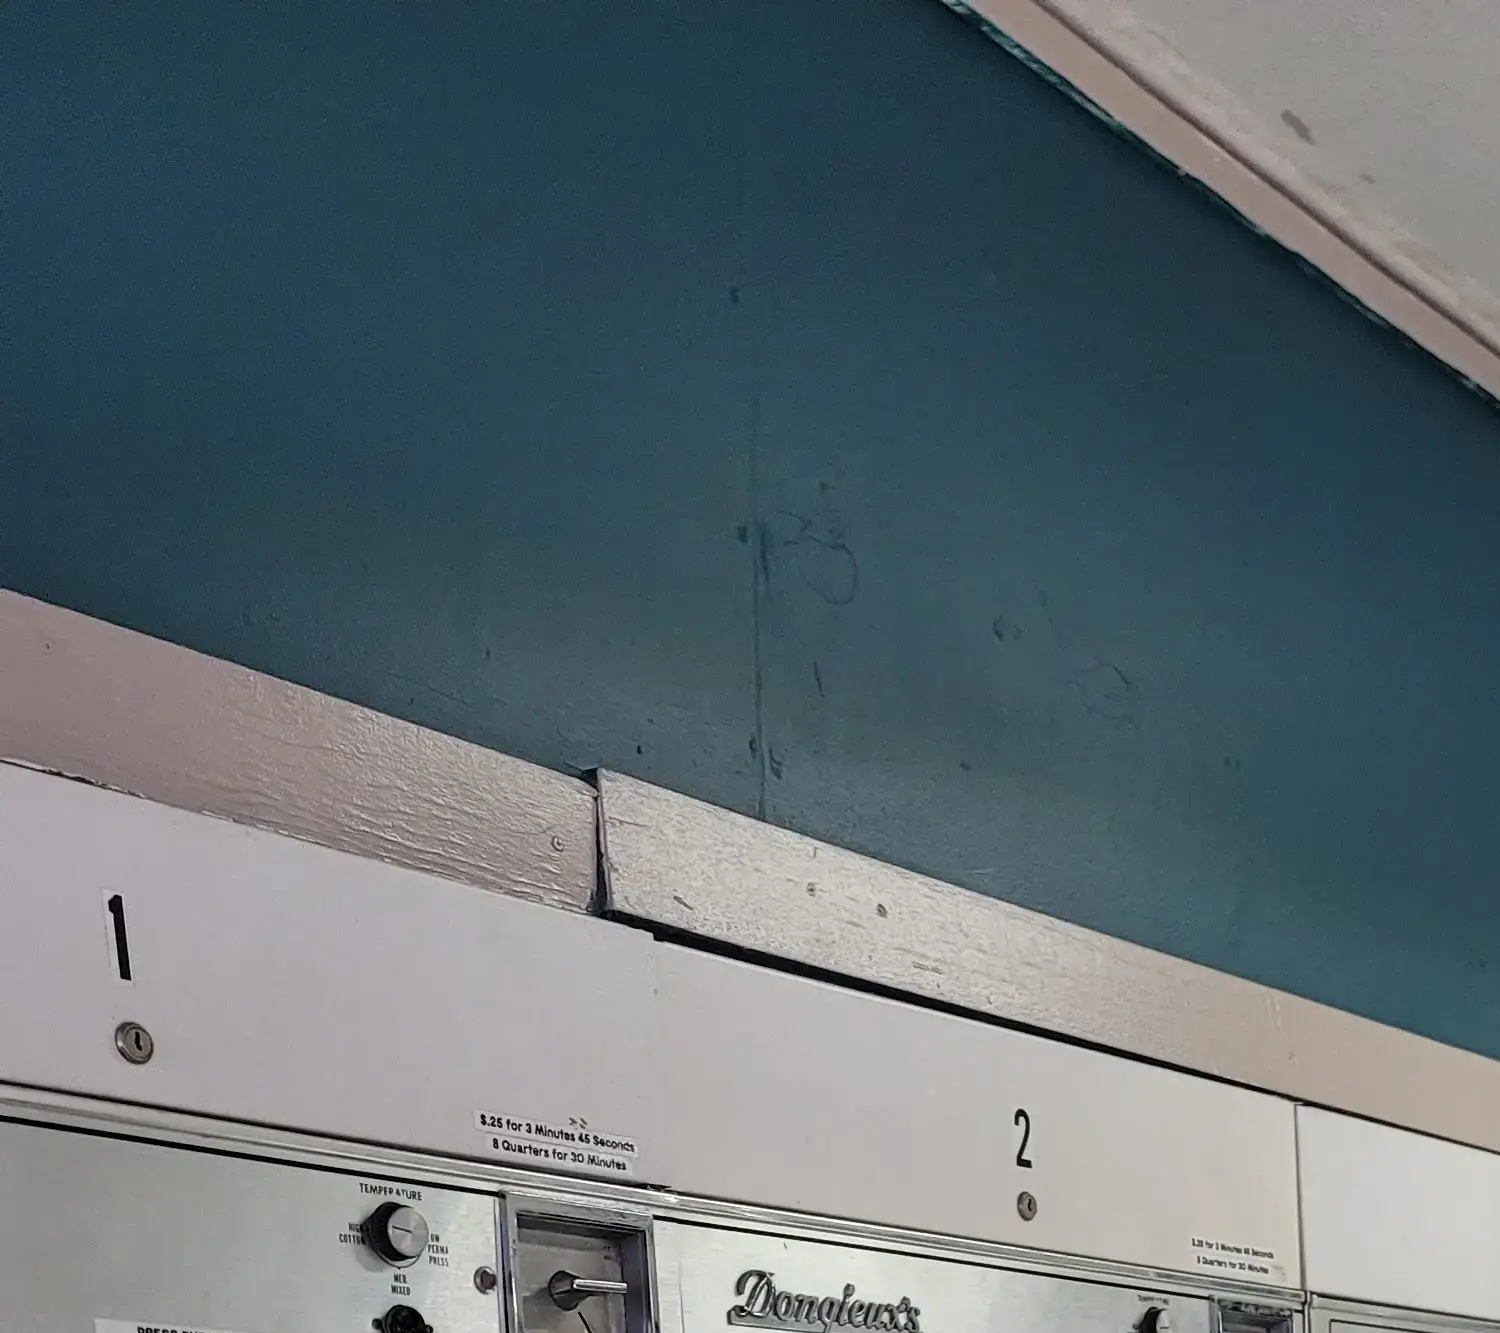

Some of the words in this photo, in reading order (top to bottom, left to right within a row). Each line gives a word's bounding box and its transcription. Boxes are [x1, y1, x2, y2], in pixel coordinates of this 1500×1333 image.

[108, 894, 132, 981] 1
[480, 1113, 503, 1129] $.25
[506, 1119, 523, 1132] for
[526, 1122, 532, 1134] 3
[535, 1124, 575, 1142] Minutes
[578, 1132, 590, 1144] 45
[593, 1134, 635, 1152] Seconds
[492, 1138, 499, 1149] 8
[502, 1139, 550, 1158] Quarters
[552, 1149, 567, 1161] for
[570, 1151, 585, 1163] 30
[587, 1155, 627, 1171] Minutes
[1014, 1108, 1032, 1168] 2
